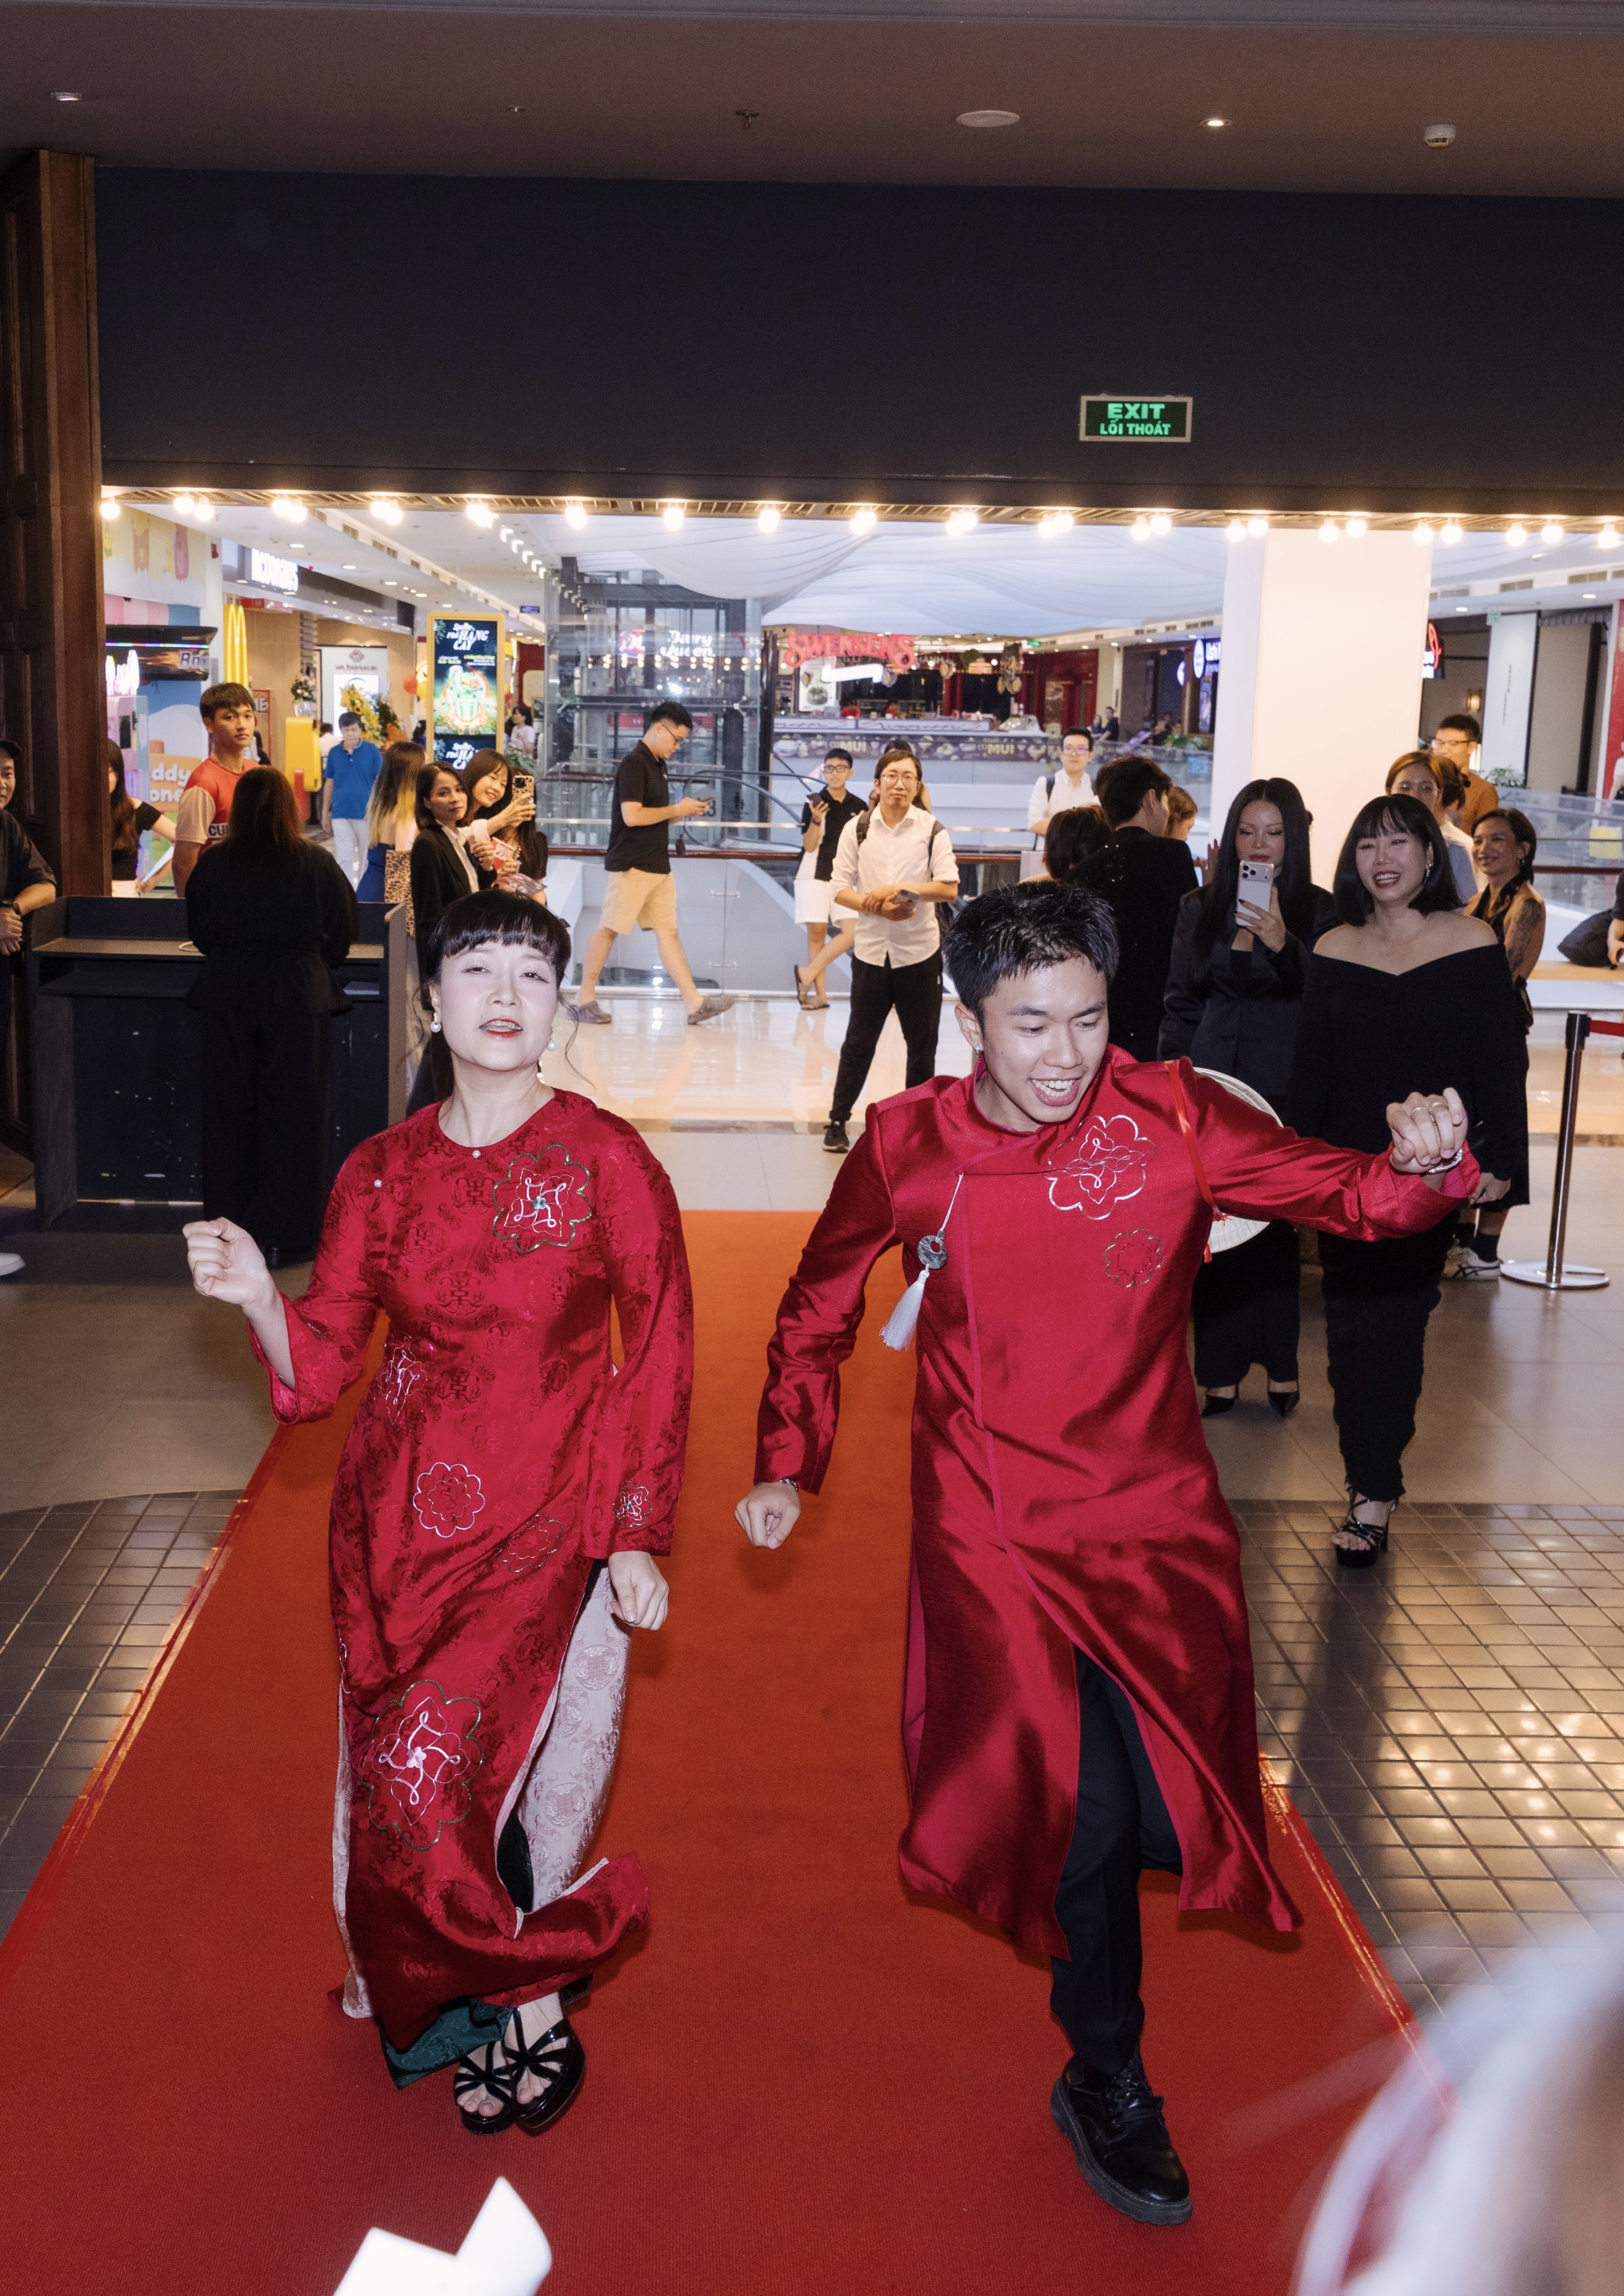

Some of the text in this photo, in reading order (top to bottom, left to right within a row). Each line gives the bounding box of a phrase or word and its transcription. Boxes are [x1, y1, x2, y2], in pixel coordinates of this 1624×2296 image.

[1108, 403, 1165, 419] EXIT
[1126, 420, 1171, 435] THOÁT
[151, 763, 192, 788] ddy
[209, 825, 225, 837] CU
